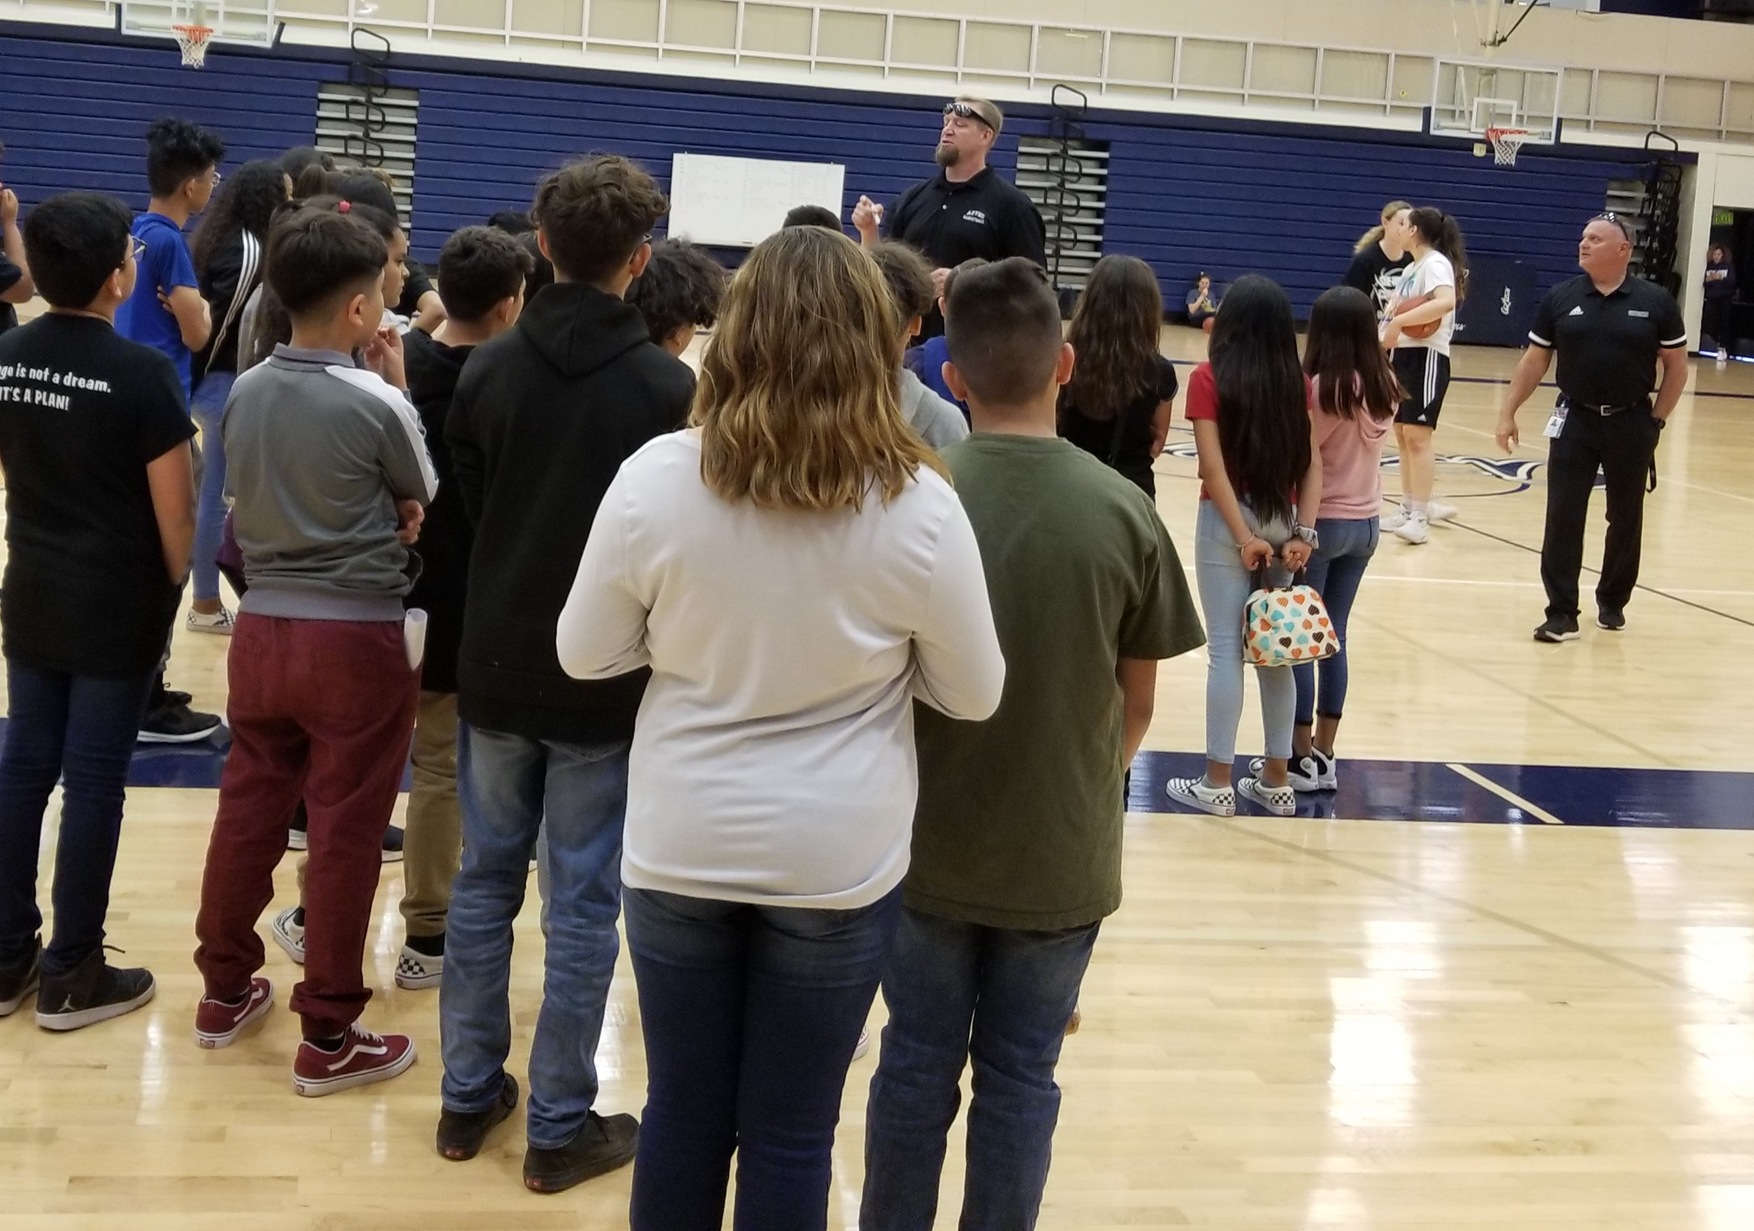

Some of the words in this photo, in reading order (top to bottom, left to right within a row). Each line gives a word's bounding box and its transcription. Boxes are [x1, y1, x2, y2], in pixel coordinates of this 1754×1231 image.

[16, 363, 27, 378] is
[29, 367, 49, 381] not
[52, 373, 60, 384] a
[63, 371, 111, 393] dream.
[23, 388, 31, 403] A
[35, 389, 70, 411] PLAN!
